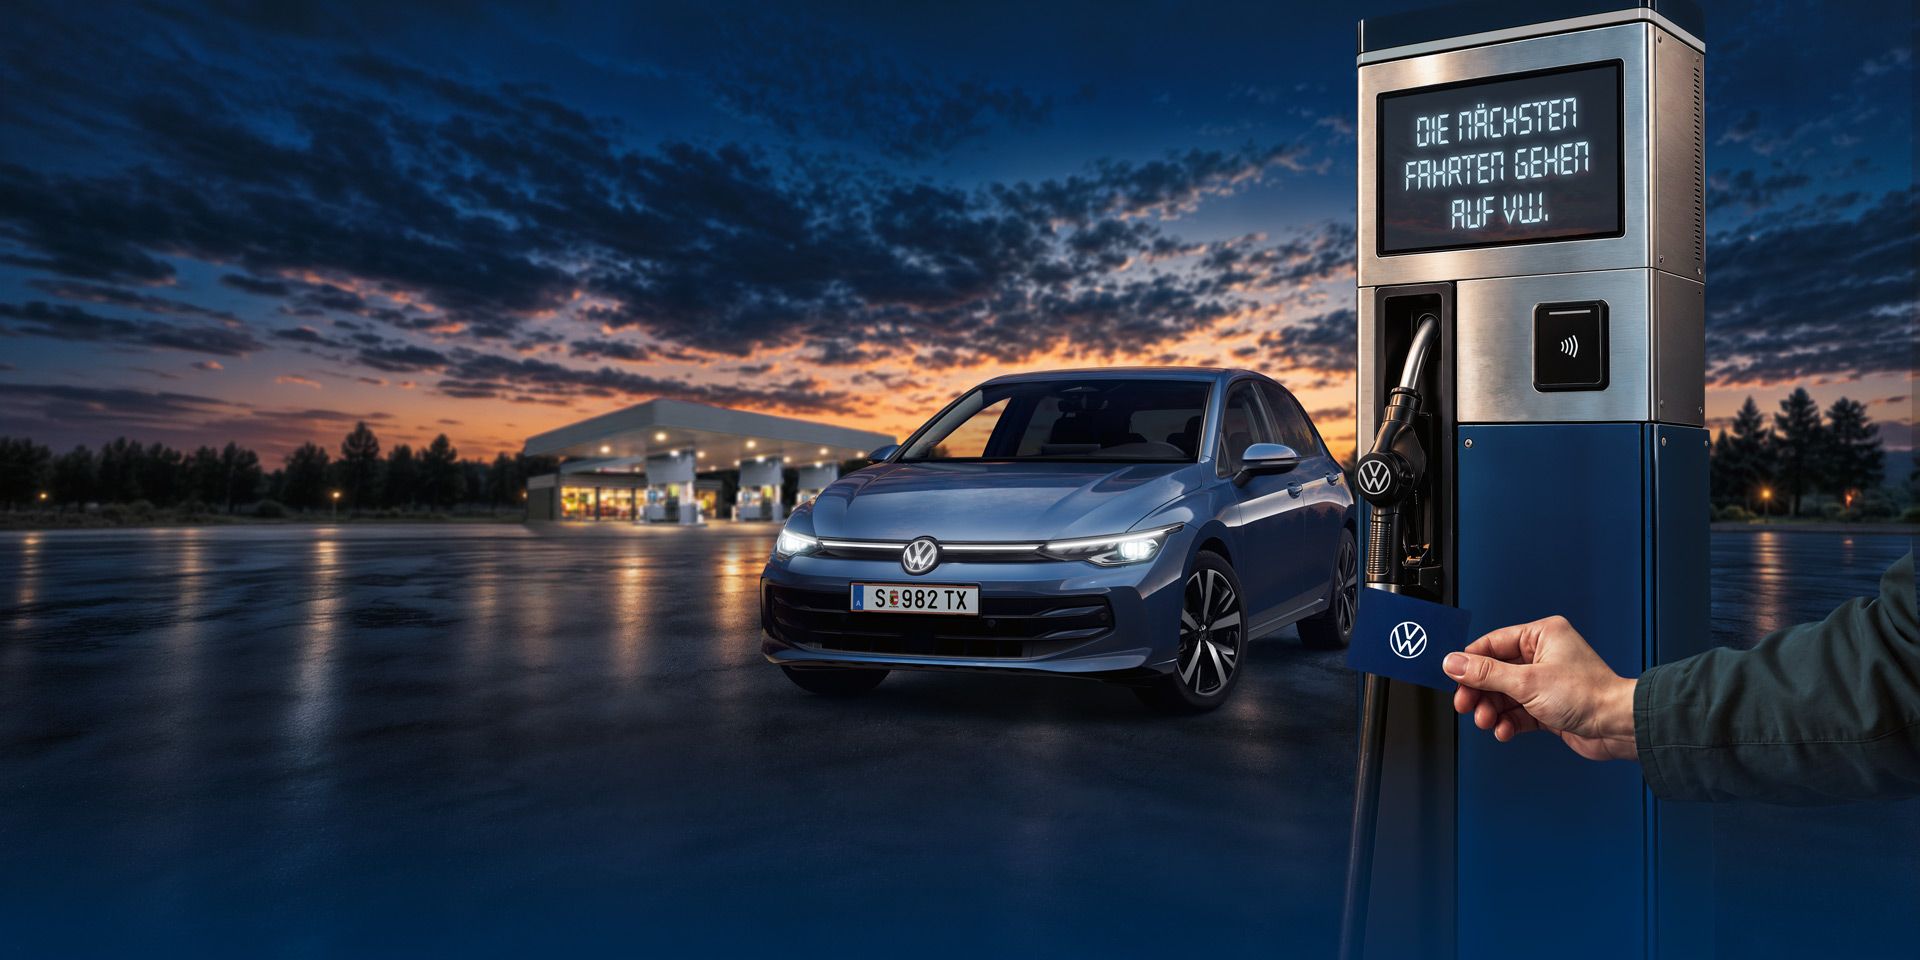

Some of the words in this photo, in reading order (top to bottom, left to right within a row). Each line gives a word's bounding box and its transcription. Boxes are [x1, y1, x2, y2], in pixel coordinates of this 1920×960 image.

[1416, 114, 1450, 148] DIE
[1458, 97, 1577, 142] NÄCHSTEN
[1405, 151, 1504, 191] FAHRTEN
[1514, 141, 1589, 180] GEHEN
[1451, 196, 1495, 230] AUF
[1503, 192, 1549, 224] VW.
[1358, 459, 1391, 495] VW
[903, 539, 938, 572] VW
[875, 588, 886, 608] S
[902, 589, 938, 609] 982
[944, 590, 967, 610] TX
[1389, 621, 1427, 659] VW
